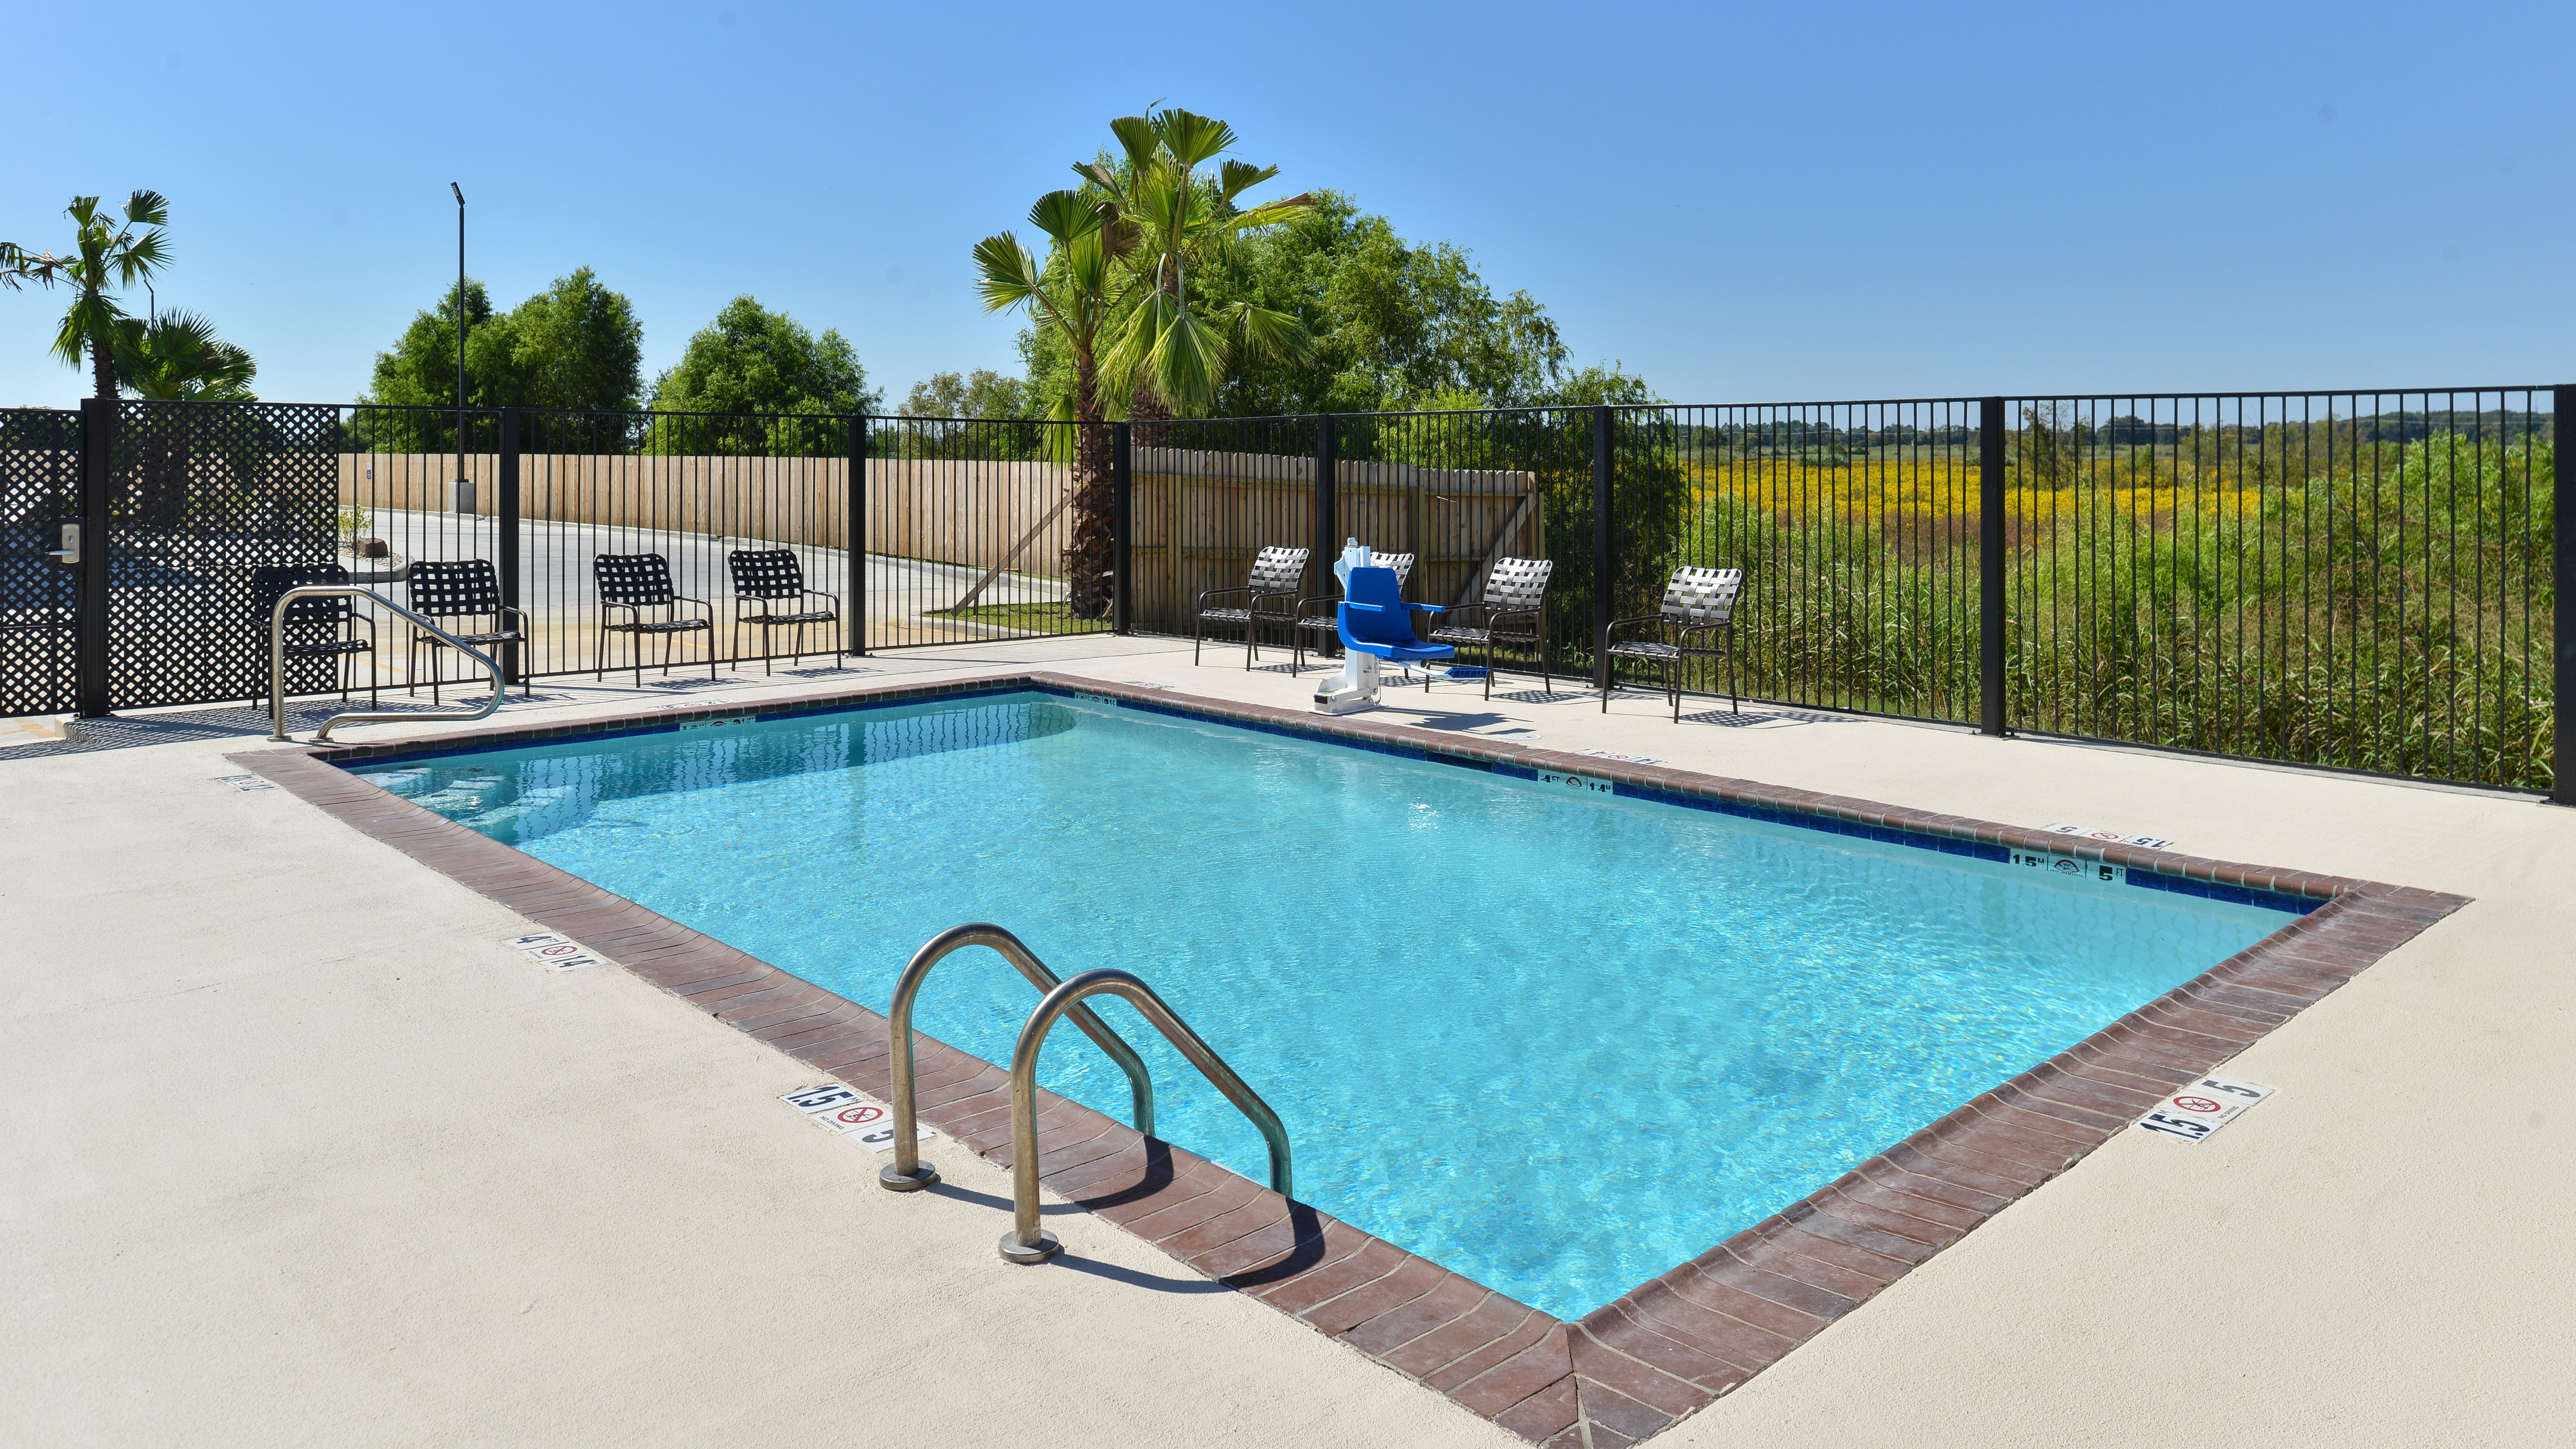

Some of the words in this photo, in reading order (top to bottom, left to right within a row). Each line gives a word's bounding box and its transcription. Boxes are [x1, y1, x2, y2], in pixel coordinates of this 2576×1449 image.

[1540, 775, 1551, 783] 4
[2099, 865, 2113, 881] 5
[2116, 868, 2124, 877] FT
[787, 1086, 854, 1107] 1.5
[2202, 1080, 2261, 1098] 5
[2224, 1106, 2240, 1115] DIVING
[826, 1120, 845, 1130] DIVING
[2140, 1113, 2210, 1140] 1.5
